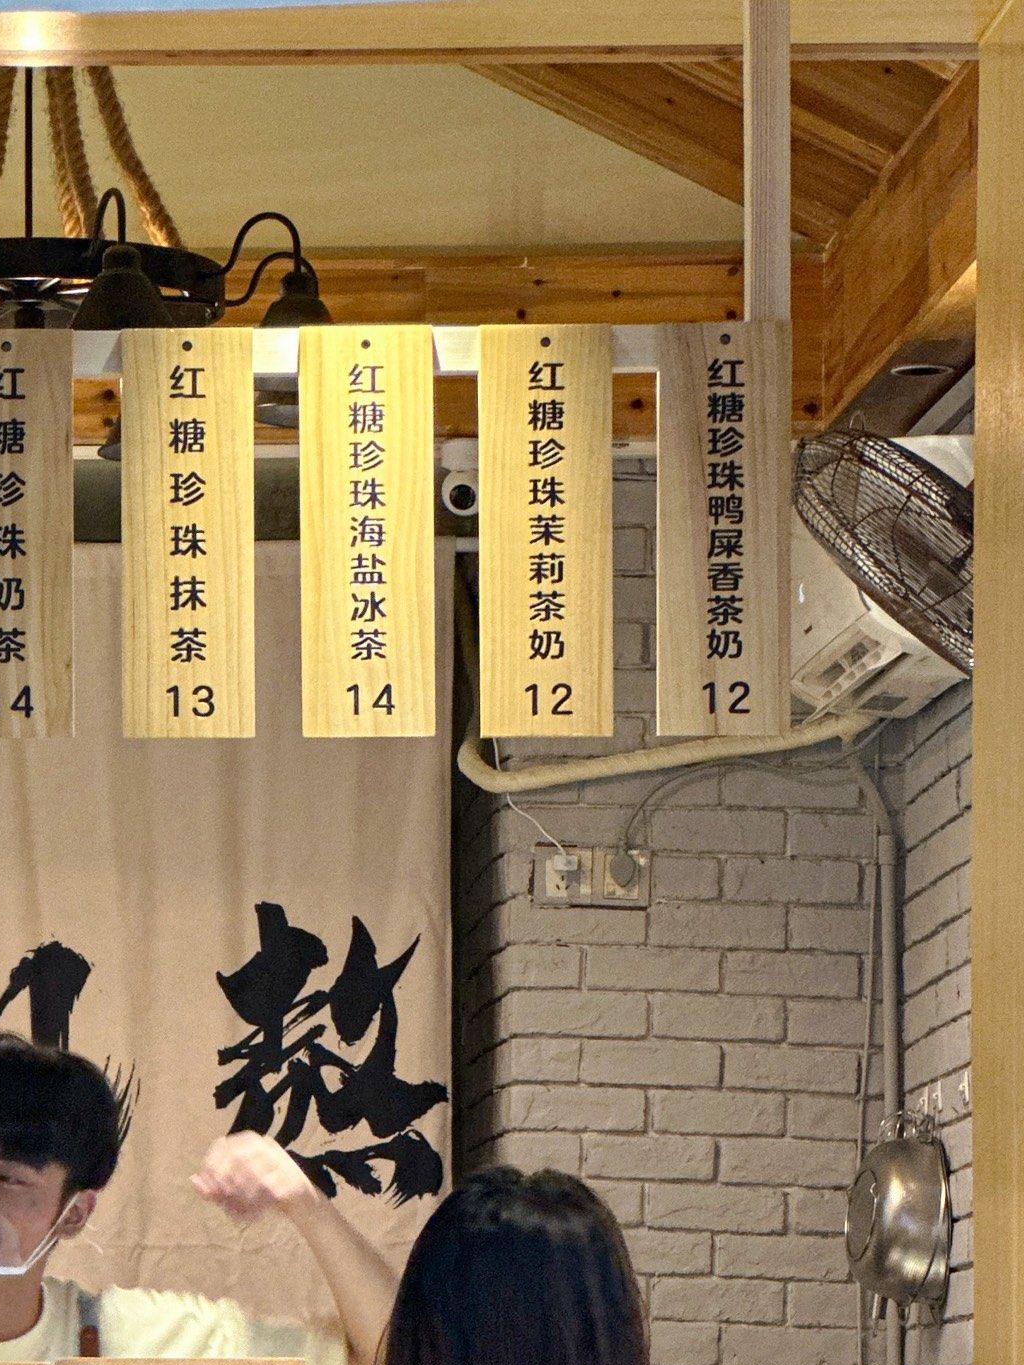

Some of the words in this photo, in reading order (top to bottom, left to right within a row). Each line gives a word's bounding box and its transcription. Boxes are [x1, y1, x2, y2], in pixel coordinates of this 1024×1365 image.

[168, 365, 207, 663] 红糖珍珠抹茶
[348, 363, 387, 661] 红糖珍珠海盐冰茶
[527, 360, 566, 660] 红糖珍珠茉莉茶奶
[706, 358, 746, 660] 红糖珍珠鸭屎香茶奶
[166, 685, 215, 718] 13
[346, 683, 396, 716] 14
[524, 682, 574, 716] 12
[702, 681, 751, 715] 12
